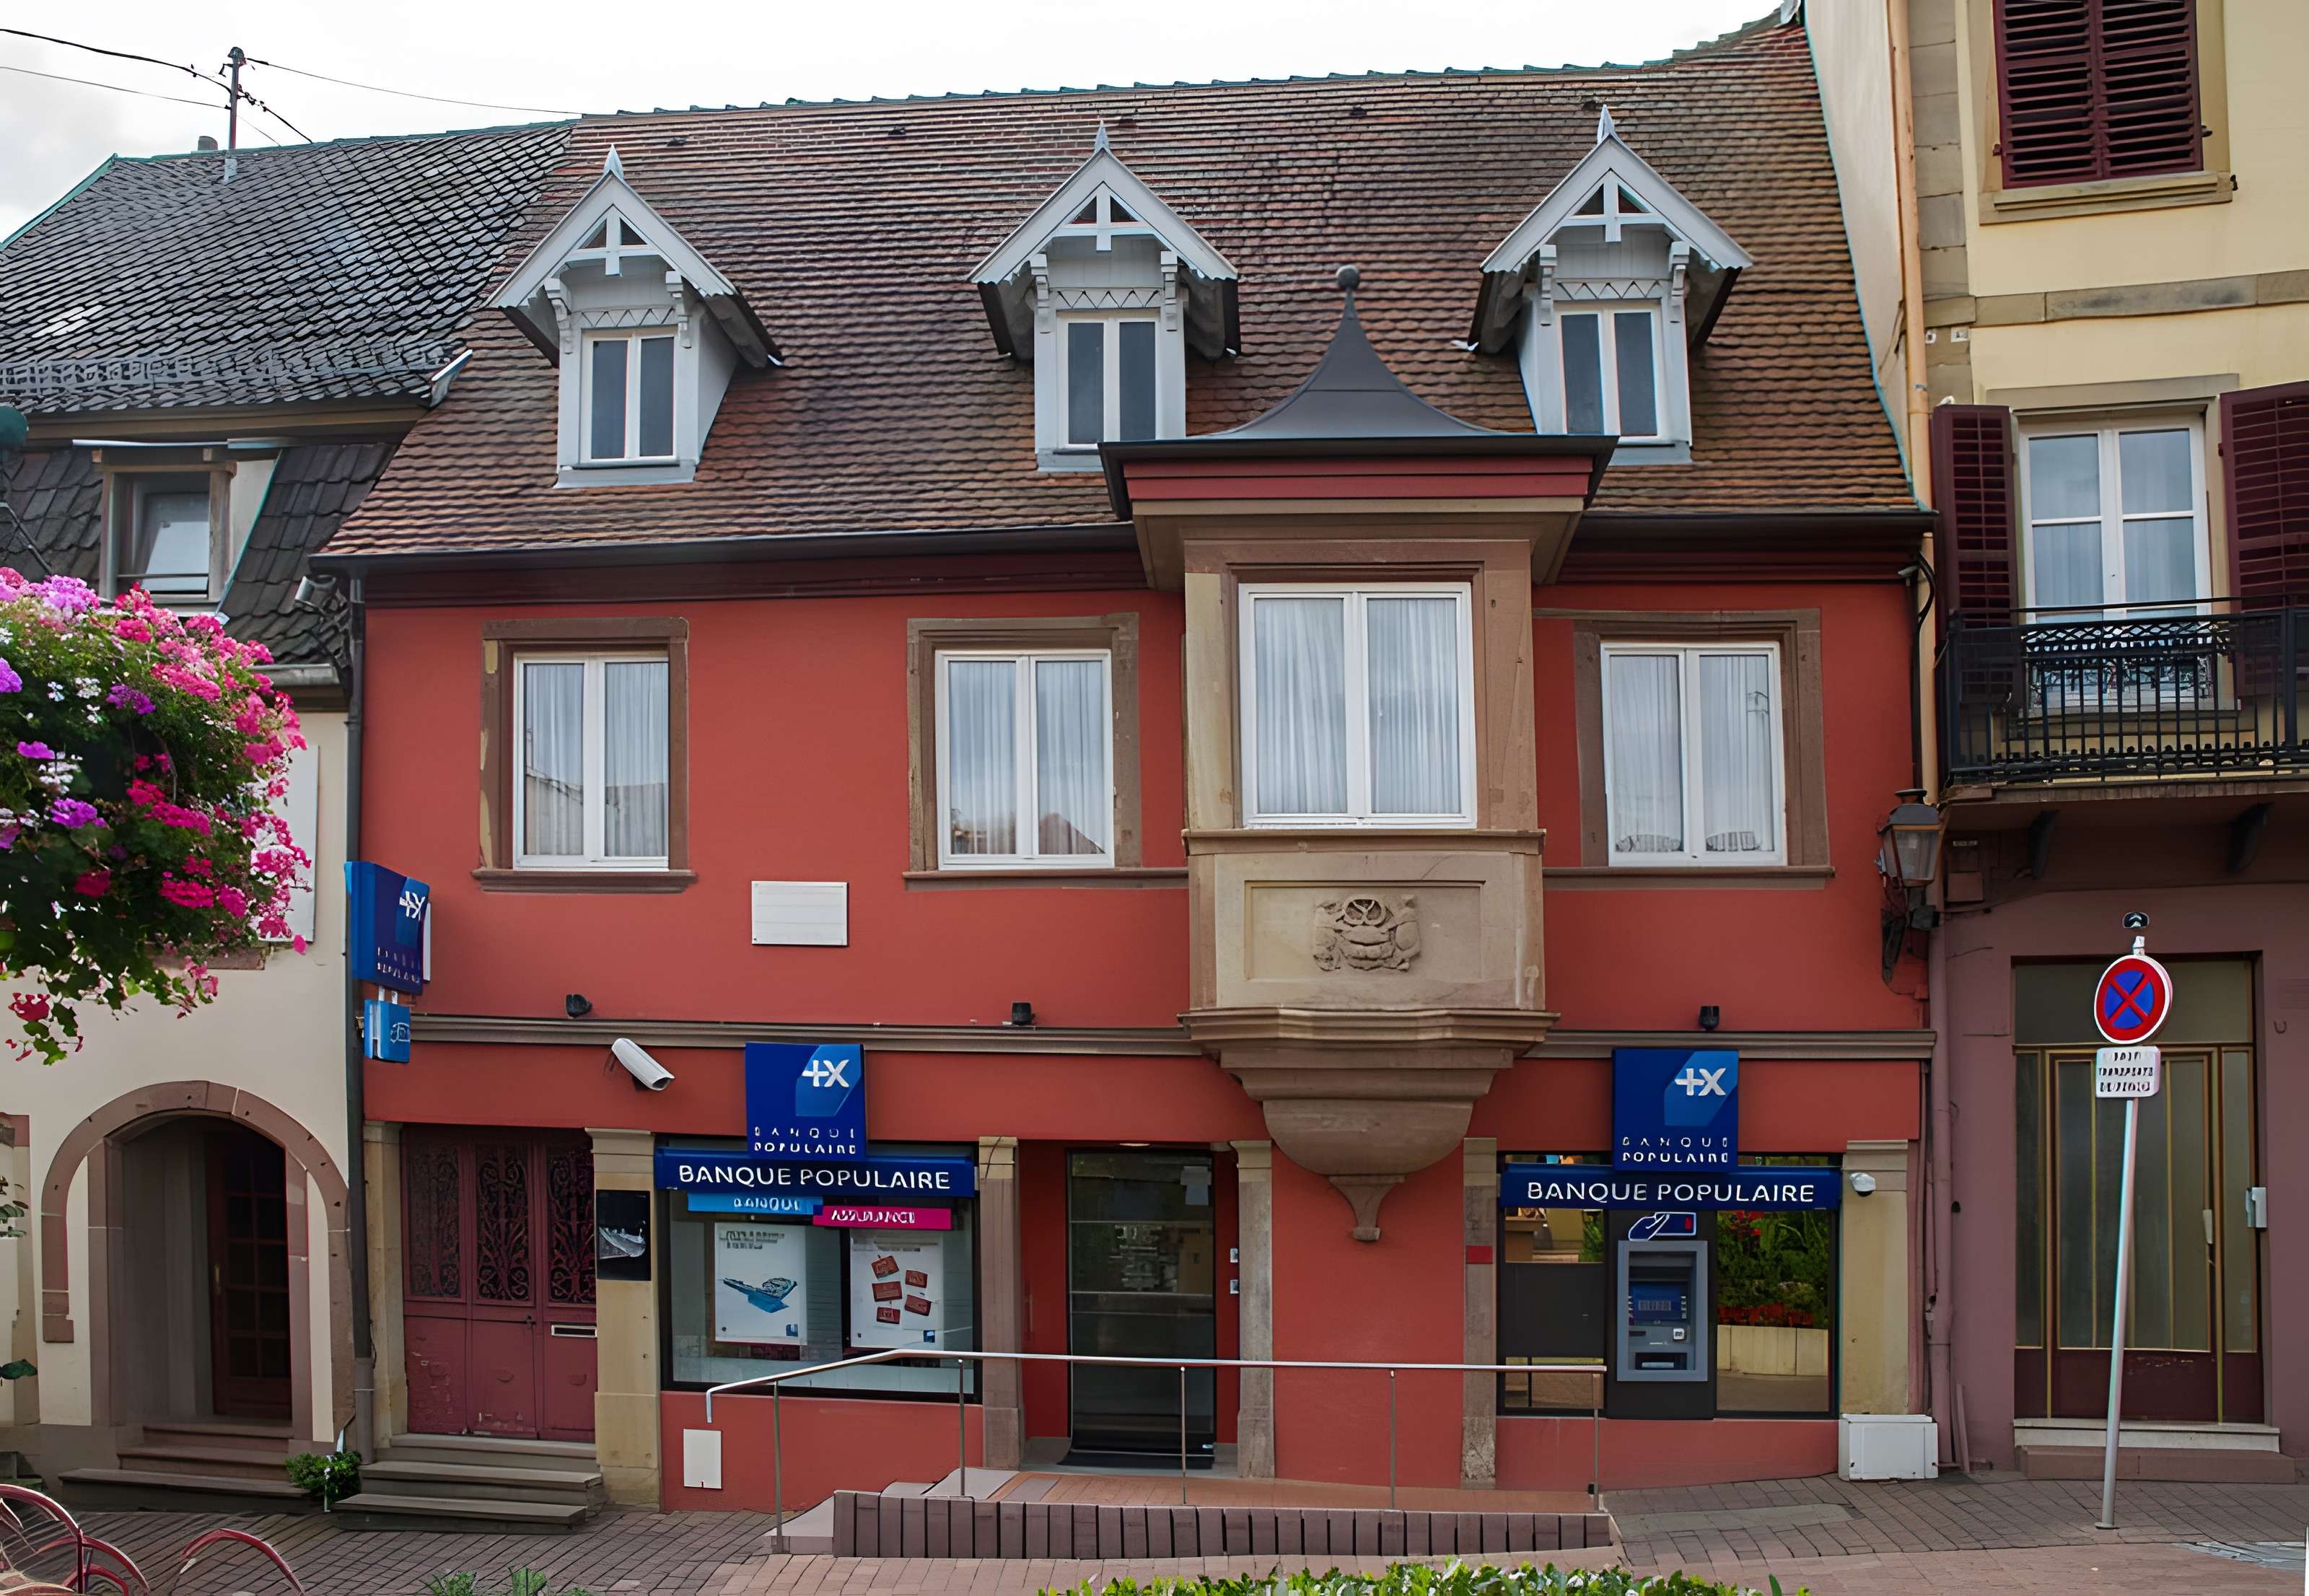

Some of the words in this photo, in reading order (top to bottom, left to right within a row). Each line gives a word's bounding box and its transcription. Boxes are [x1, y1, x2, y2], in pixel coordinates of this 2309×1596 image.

[679, 1165, 792, 1188] BANQUE
[800, 1169, 950, 1190] POPULAIRE
[1528, 1182, 1647, 1203] BANQUE
[1657, 1184, 1814, 1202] POPULAIRE
